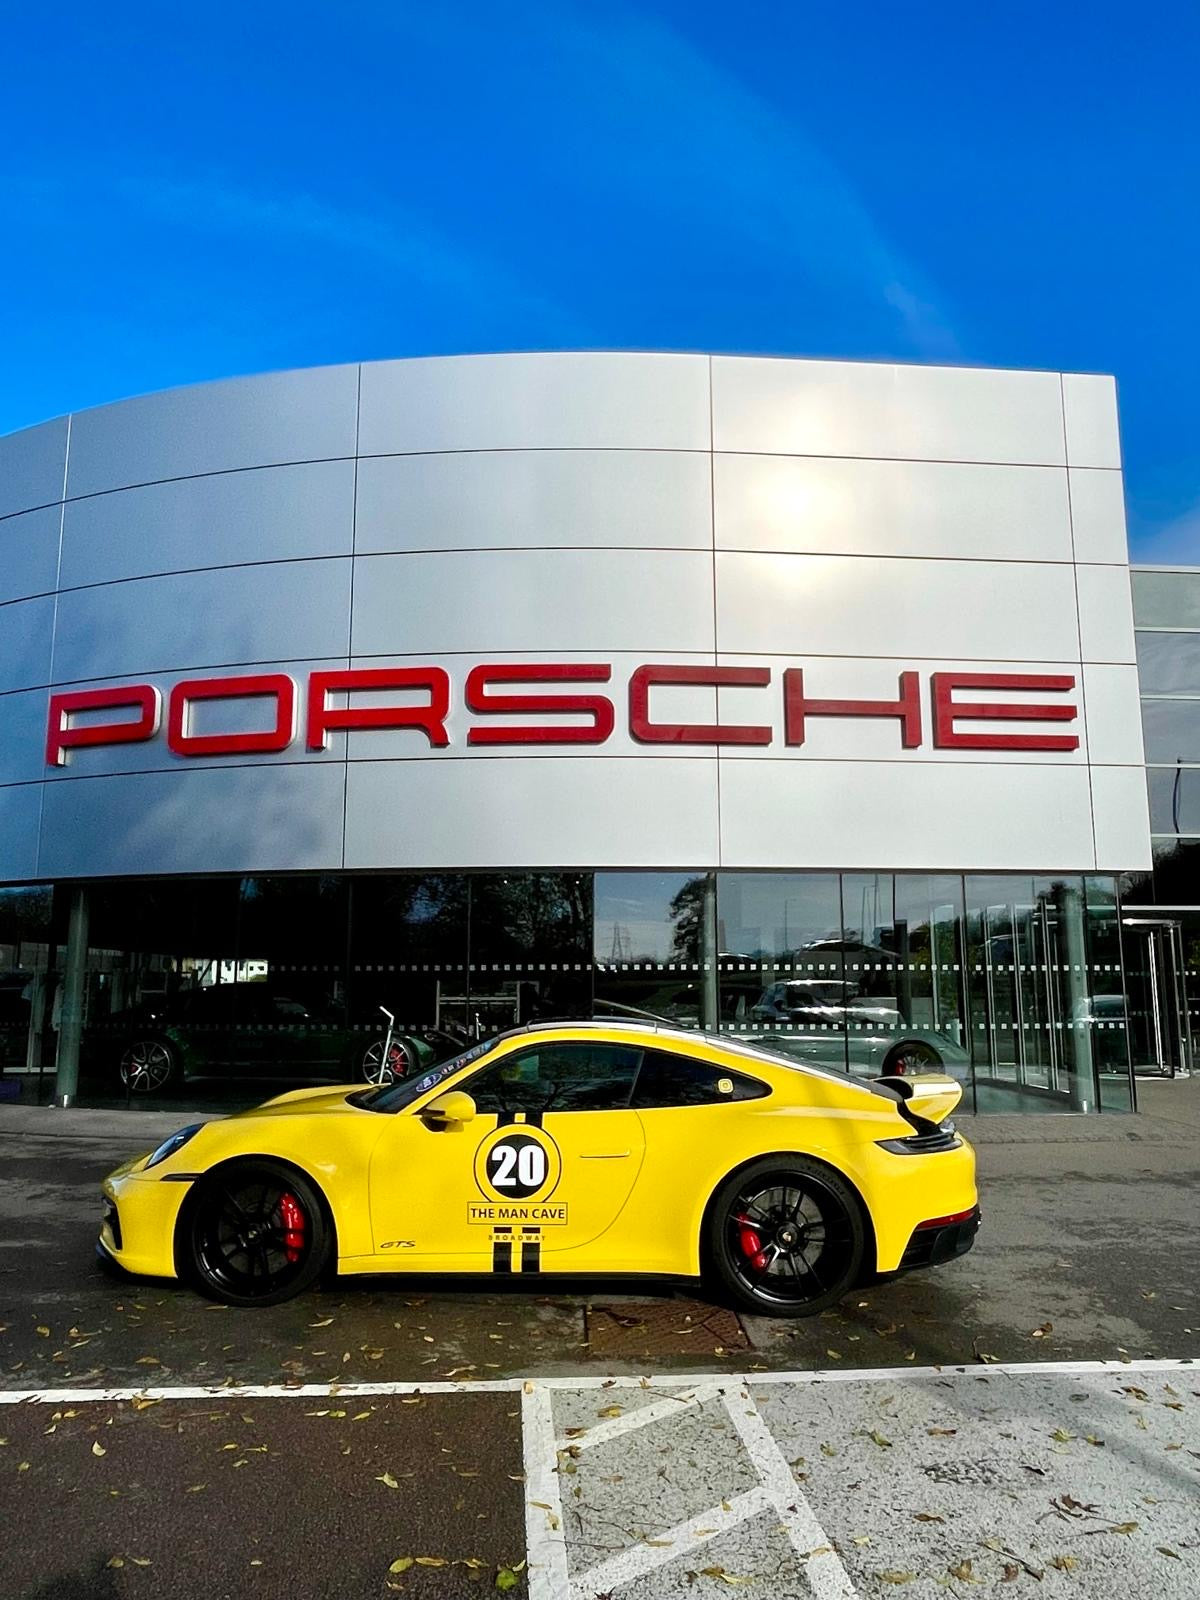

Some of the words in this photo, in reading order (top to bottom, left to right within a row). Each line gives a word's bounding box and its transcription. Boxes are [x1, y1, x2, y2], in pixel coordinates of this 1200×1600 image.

[48, 663, 1079, 767] PORSCHE
[491, 1144, 545, 1187] 20
[471, 1208, 495, 1219] THE
[498, 1208, 528, 1219] MAN
[531, 1208, 565, 1220] CAVE
[380, 1240, 416, 1249] GTS
